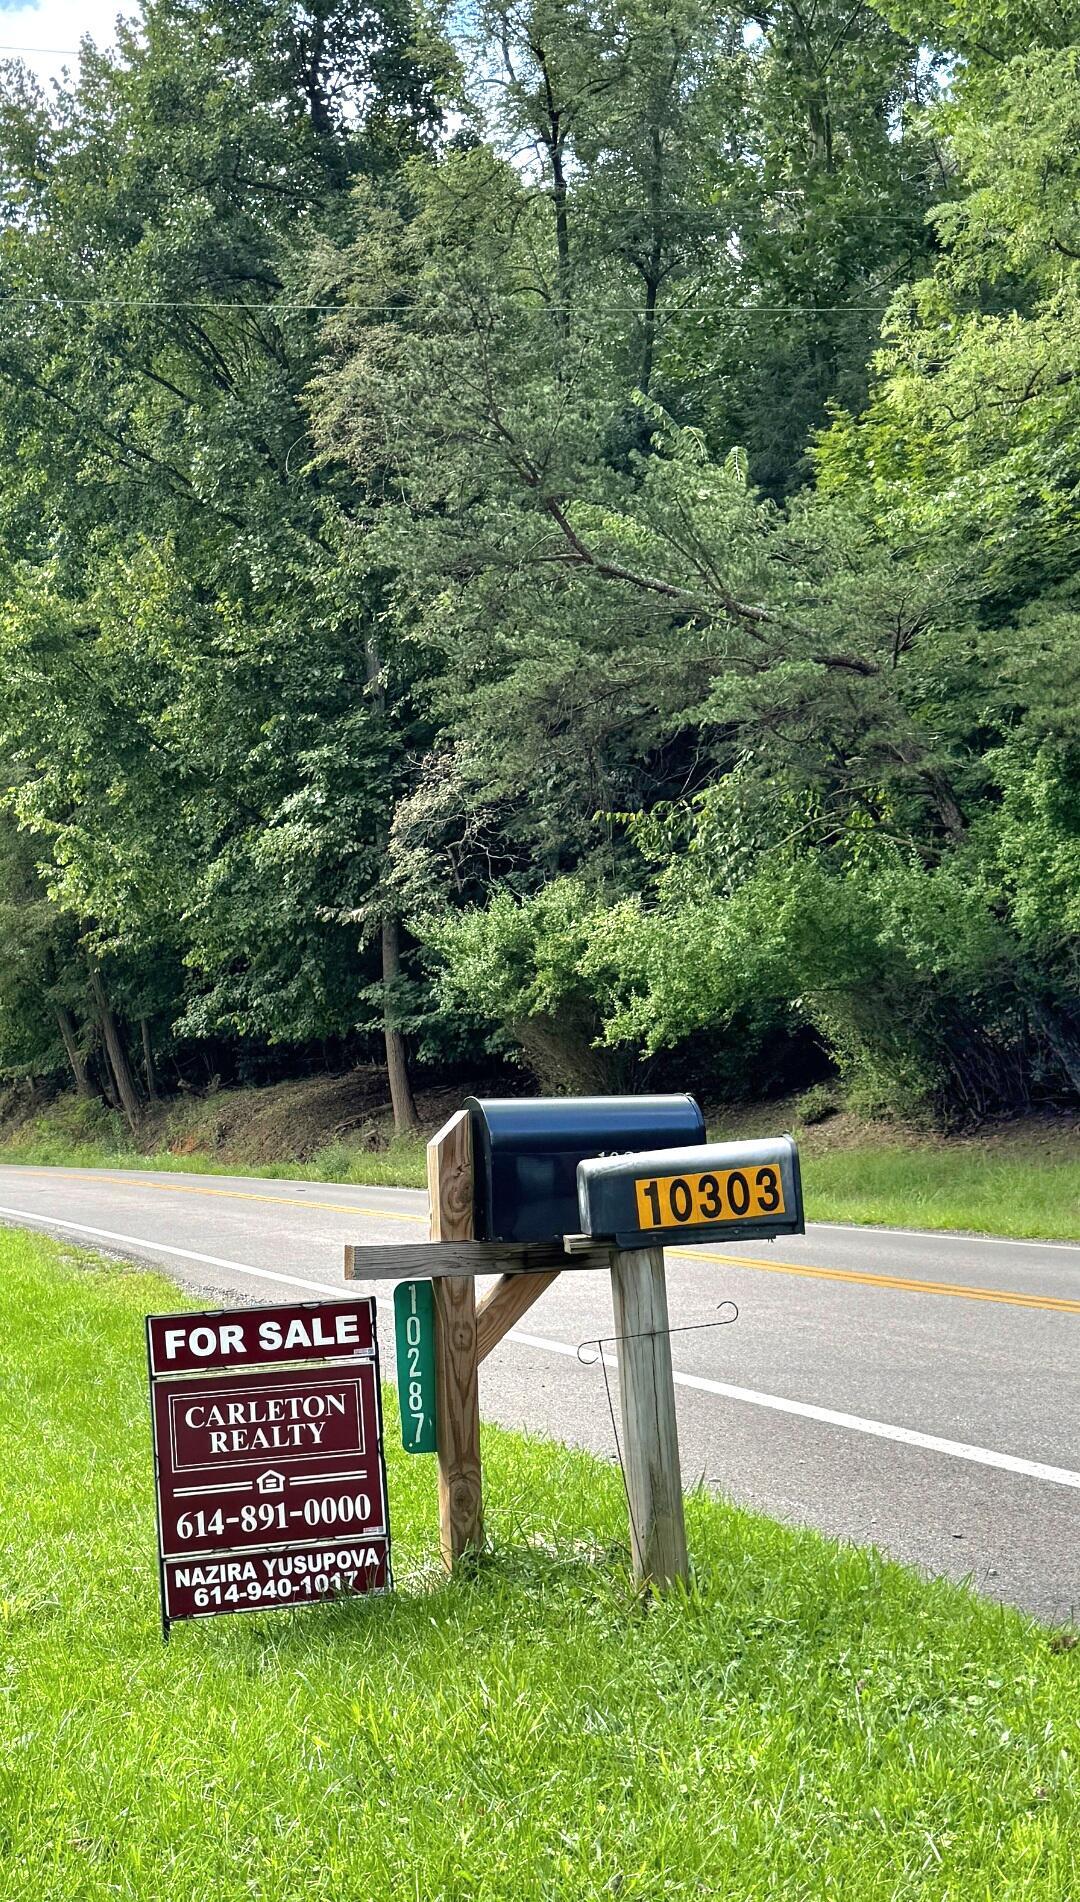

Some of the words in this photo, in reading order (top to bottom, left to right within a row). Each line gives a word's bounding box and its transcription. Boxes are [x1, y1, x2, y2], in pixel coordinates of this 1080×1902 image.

[642, 1167, 781, 1226] 10303
[164, 1325, 247, 1359] FOR
[259, 1315, 360, 1350] SALE
[406, 1283, 425, 1443] 10287
[184, 1393, 347, 1430] CARLETON
[209, 1421, 326, 1454] REALTY
[176, 1493, 371, 1539] 614-891-0000
[174, 1561, 258, 1588] NAZIRA
[262, 1547, 380, 1578] YUSUPOVA
[194, 1570, 359, 1607] 614-940-1017
